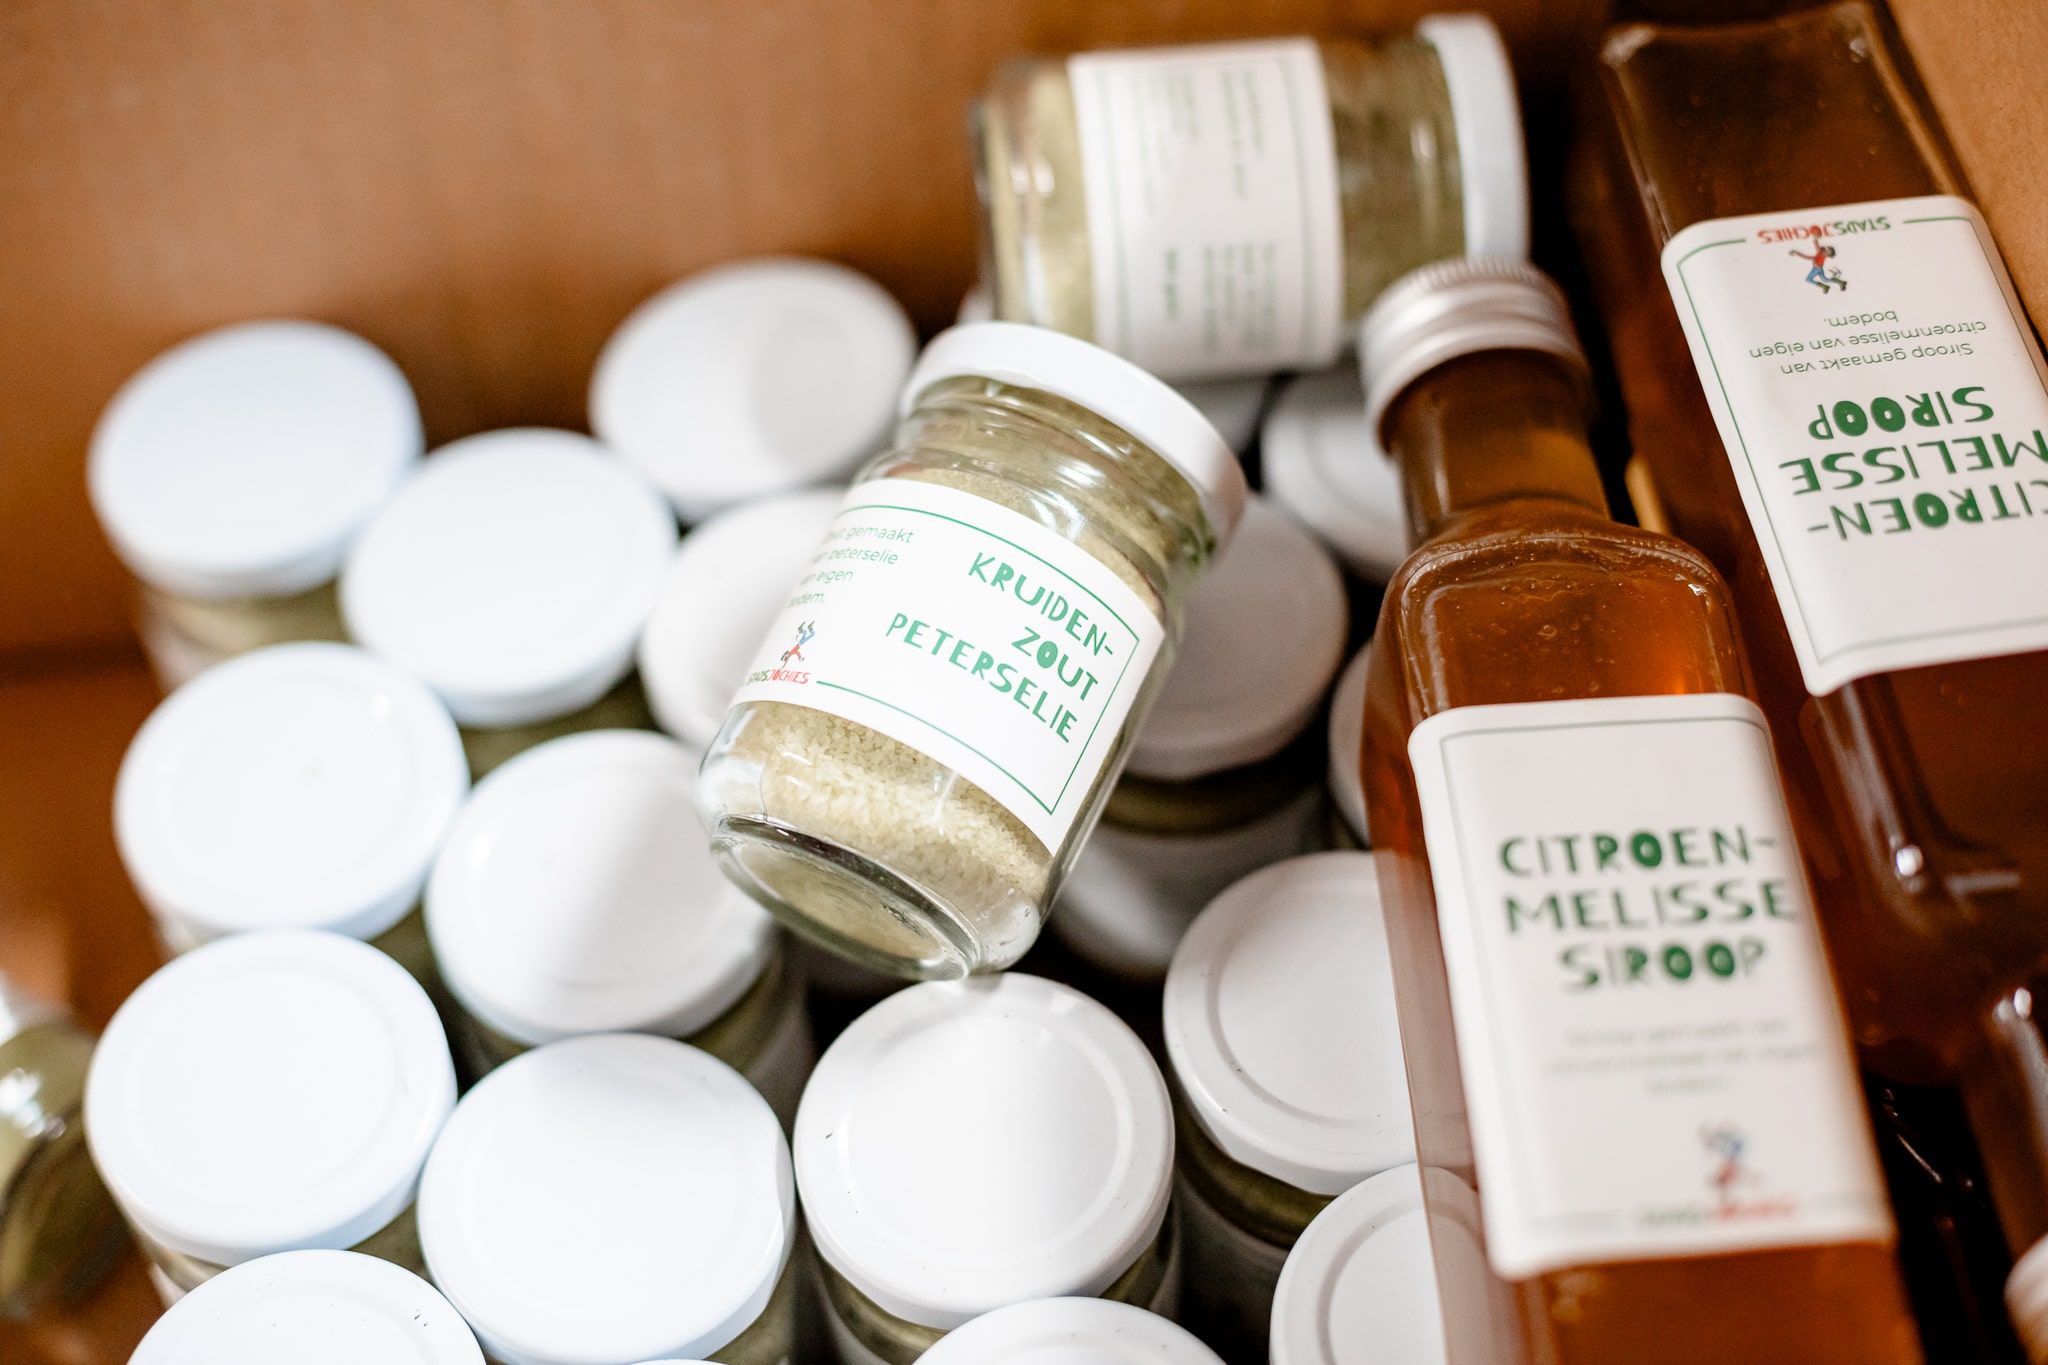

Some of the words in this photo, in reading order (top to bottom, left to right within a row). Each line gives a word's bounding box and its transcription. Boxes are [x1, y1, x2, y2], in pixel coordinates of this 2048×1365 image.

[1823, 310, 1898, 329] bodem.
[1810, 338, 1844, 351] van
[1849, 320, 1987, 347] citroenmelisse
[1749, 342, 1804, 359] eigen
[1821, 351, 1906, 371] gemaakt
[1912, 343, 1974, 360] Siroop
[1780, 363, 1817, 375] van
[1808, 387, 1994, 440] SIROOP
[1779, 430, 2048, 495] MELISSE
[846, 527, 914, 543] gemaakt
[828, 547, 898, 564] peterselie
[816, 570, 853, 584] eigen
[968, 552, 1113, 656] KRUIDEN-
[1012, 627, 1098, 701] ZOUT
[885, 613, 1078, 743] PETERSELIE
[1499, 825, 1777, 876] CITROEN-
[1505, 879, 1799, 935] MELISSE
[1561, 938, 1766, 991] SIROOP
